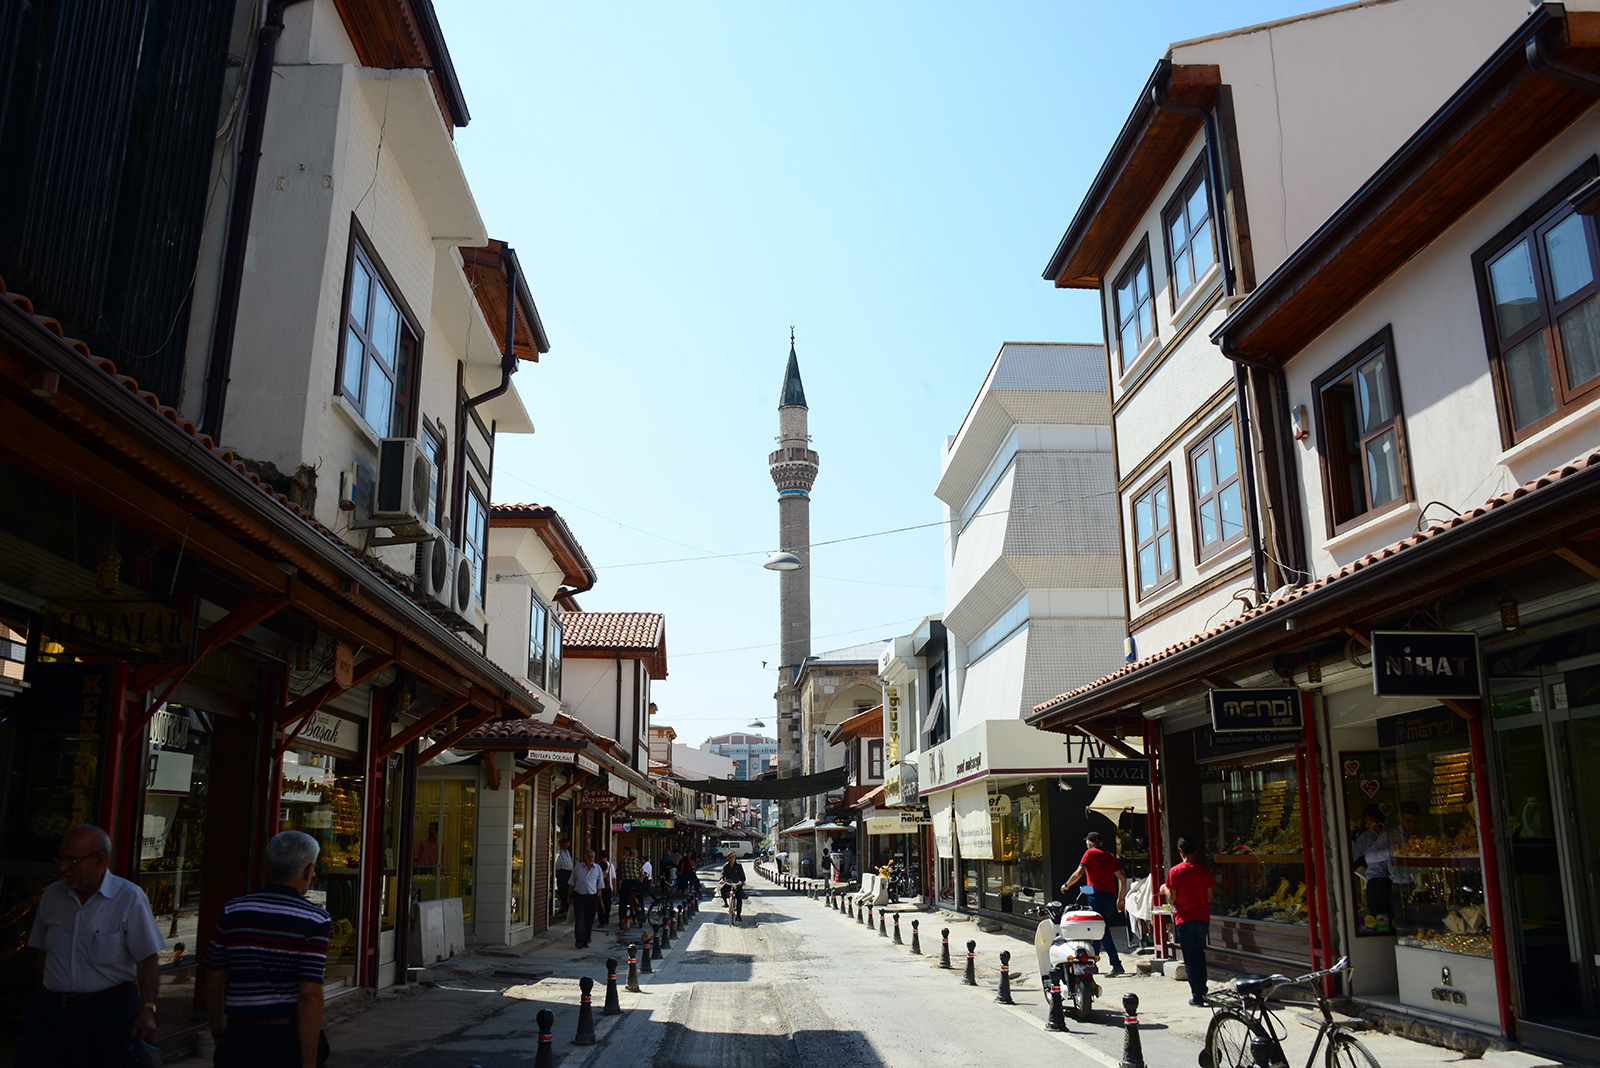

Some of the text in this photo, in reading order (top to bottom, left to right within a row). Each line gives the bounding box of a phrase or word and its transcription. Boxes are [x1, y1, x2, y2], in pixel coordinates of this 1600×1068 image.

[50, 612, 184, 643] KENANLAR
[68, 674, 104, 832] KENANLA
[1094, 764, 1145, 779] NİYAZİ
